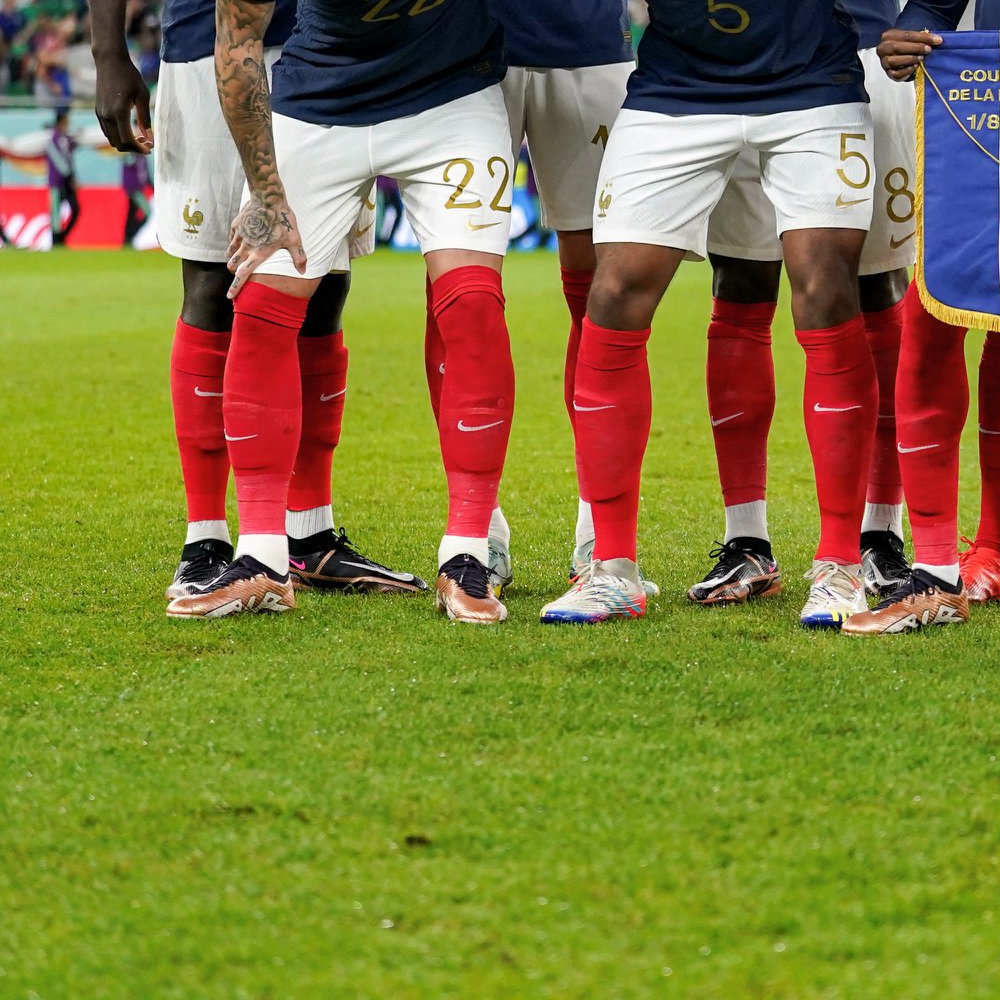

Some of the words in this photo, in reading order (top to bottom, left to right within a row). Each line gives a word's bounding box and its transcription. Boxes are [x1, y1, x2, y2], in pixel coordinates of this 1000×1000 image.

[949, 88, 970, 101] DE
[974, 88, 995, 102] LA
[966, 113, 1000, 130] 1/8
[836, 133, 870, 190] 5
[442, 156, 512, 213] 22
[884, 167, 915, 223] 8
[203, 591, 292, 619] AIR
[881, 603, 965, 634] AIR
